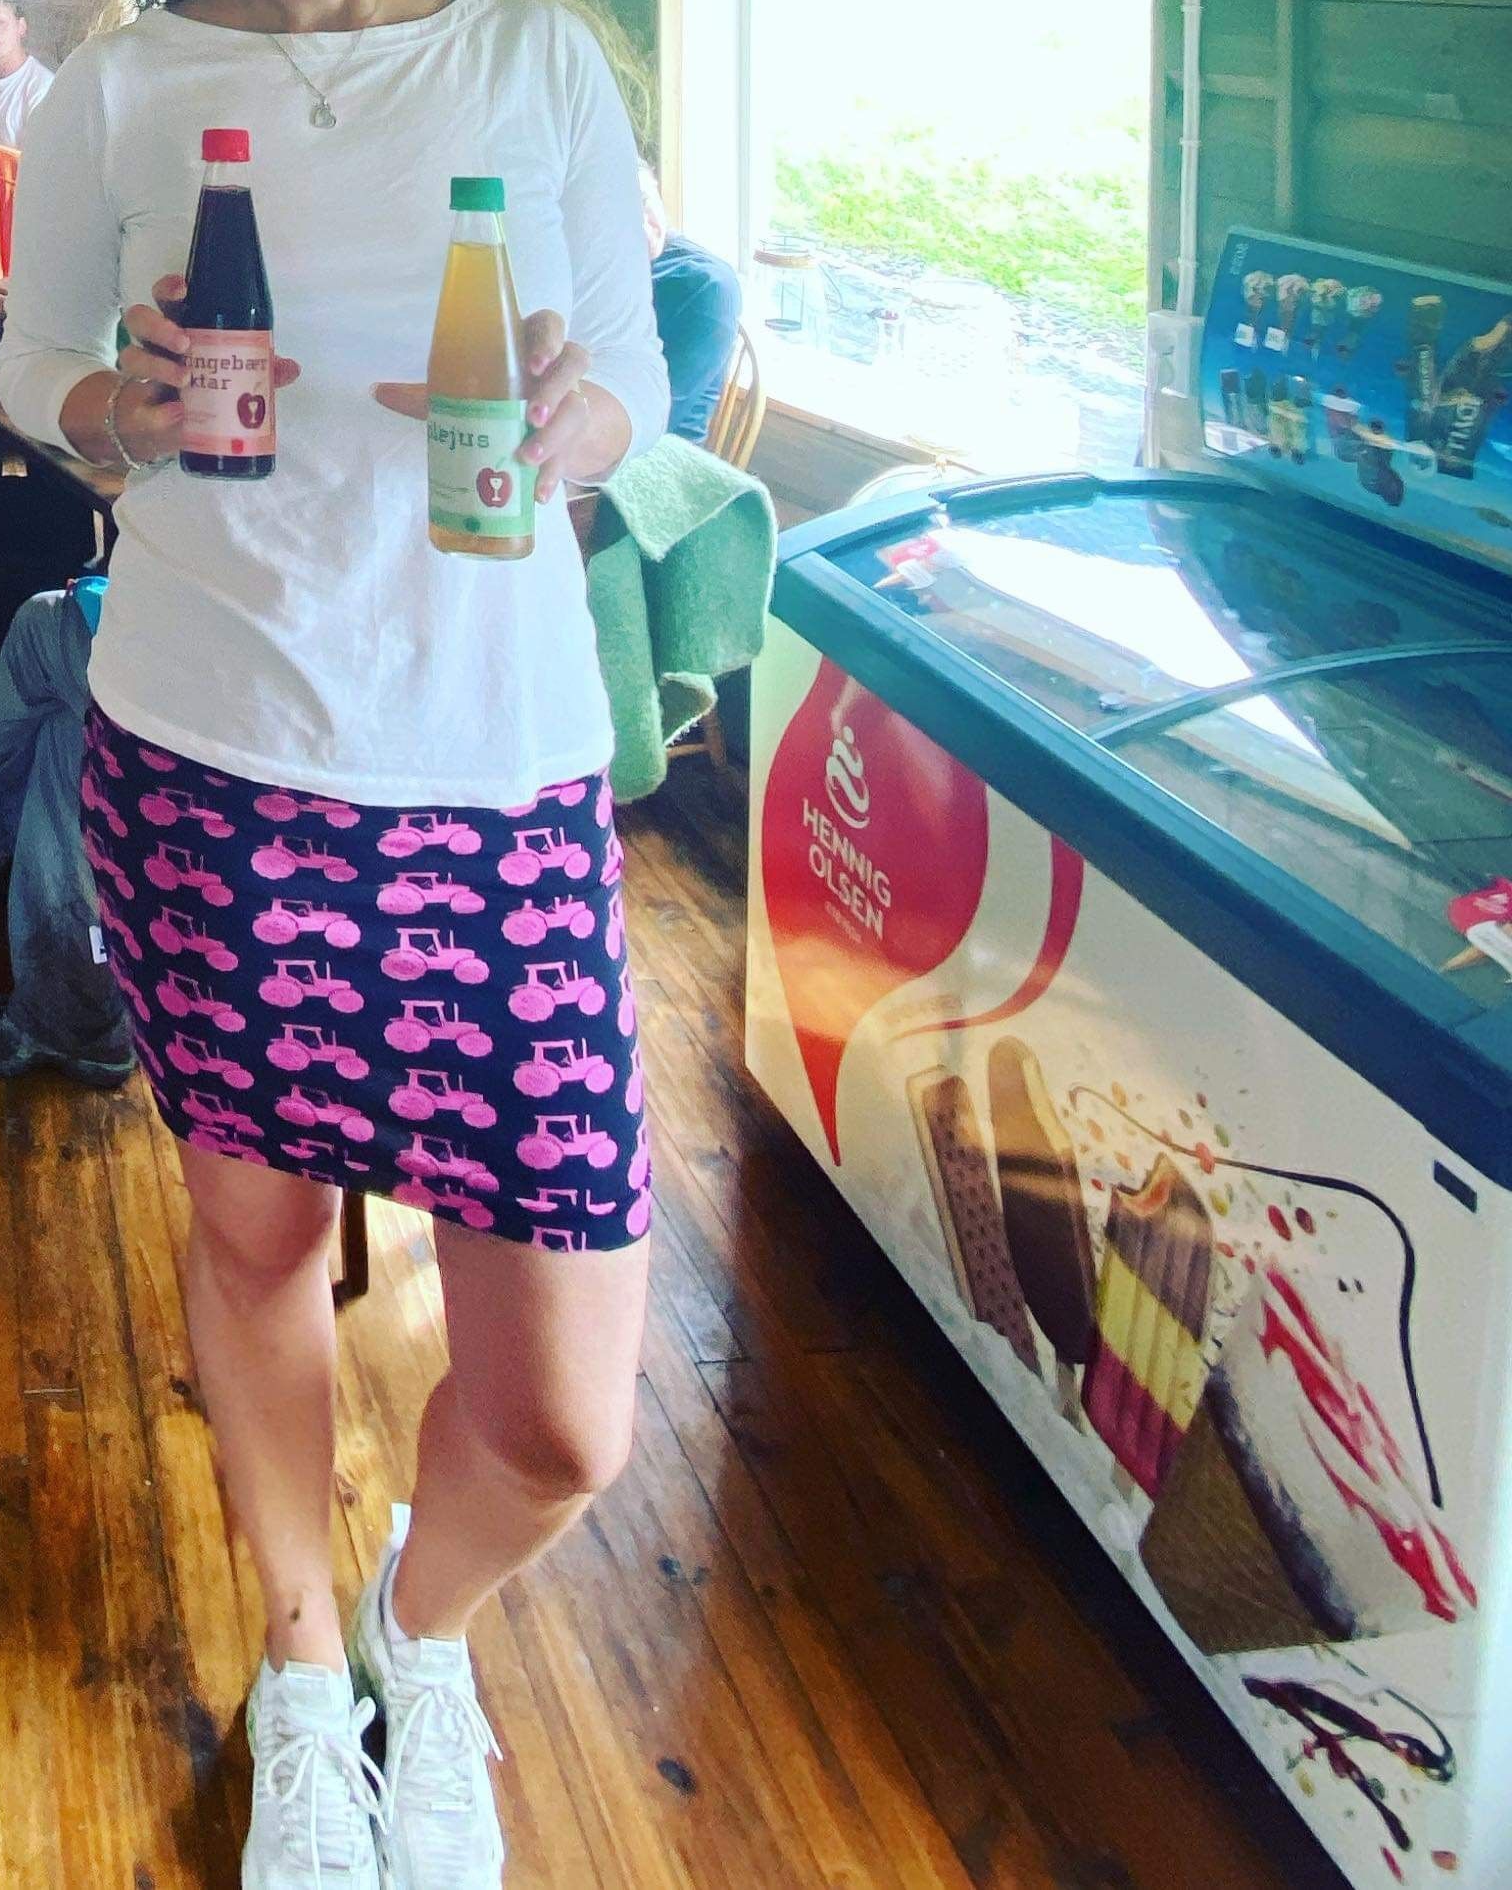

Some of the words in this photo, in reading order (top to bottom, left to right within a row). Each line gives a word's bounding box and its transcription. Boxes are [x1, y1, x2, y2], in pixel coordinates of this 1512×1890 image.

[190, 372, 232, 390] ktar
[803, 797, 891, 908] HENNIG
[809, 844, 883, 940] OLSEN
